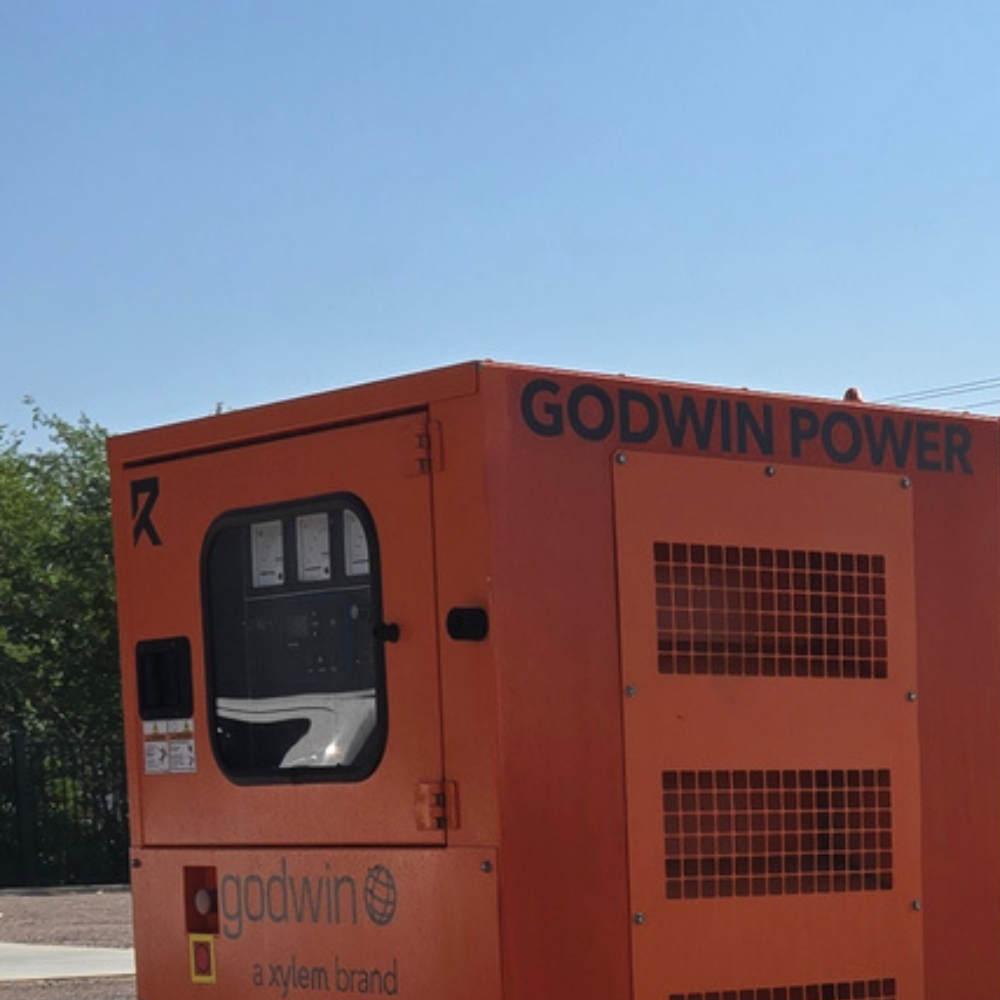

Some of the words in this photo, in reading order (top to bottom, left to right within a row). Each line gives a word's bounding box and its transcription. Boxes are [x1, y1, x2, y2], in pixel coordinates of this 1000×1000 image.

[521, 377, 774, 456] GODWIN
[790, 407, 974, 475] POWER
[221, 857, 358, 941] godwin
[252, 963, 264, 987] a
[268, 955, 331, 998] xylem
[334, 956, 399, 996] brand
